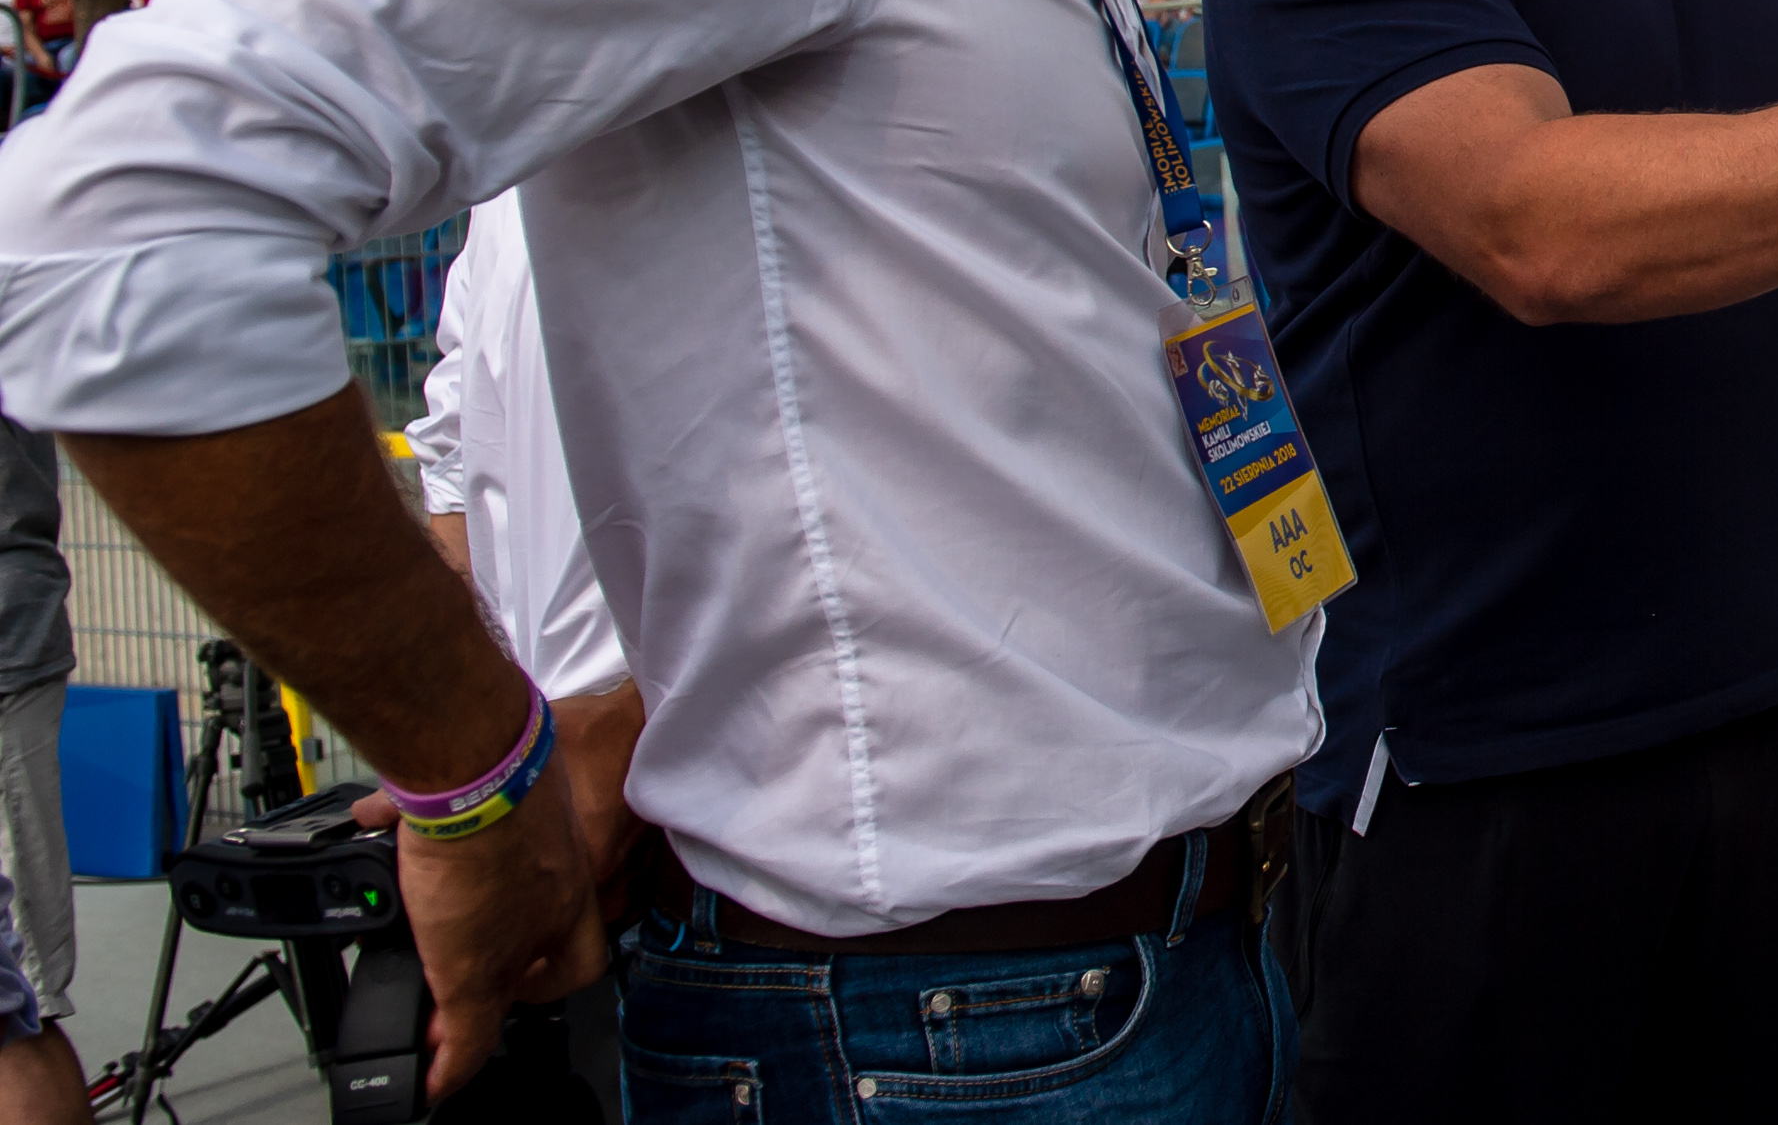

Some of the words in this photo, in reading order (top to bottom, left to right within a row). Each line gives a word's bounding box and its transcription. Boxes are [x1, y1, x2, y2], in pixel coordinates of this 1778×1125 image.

[1197, 404, 1241, 434] MEMORIAŁ
[1202, 424, 1232, 449] KAMILI
[1208, 420, 1272, 463] SKOLIMOWSKIEJ
[1220, 476, 1236, 495] 22
[1233, 455, 1277, 487] SIERPNIA
[1274, 443, 1297, 465] 2018
[1269, 507, 1309, 553] AAA
[1289, 549, 1313, 579] OC
